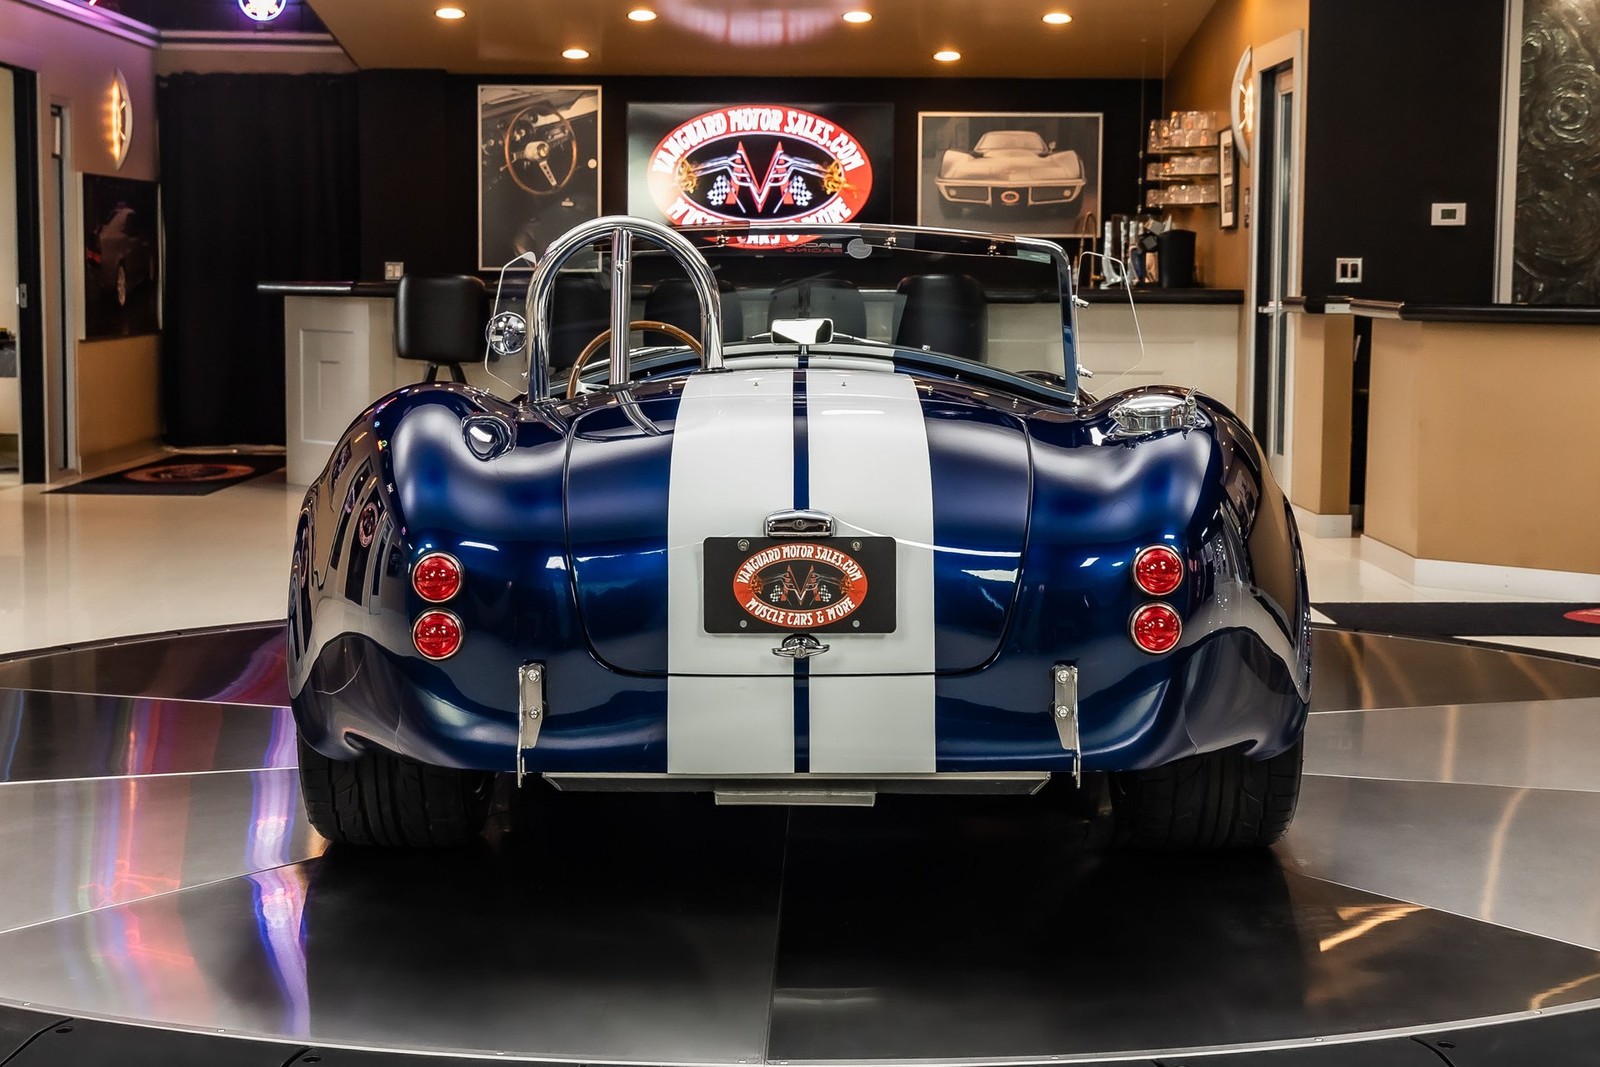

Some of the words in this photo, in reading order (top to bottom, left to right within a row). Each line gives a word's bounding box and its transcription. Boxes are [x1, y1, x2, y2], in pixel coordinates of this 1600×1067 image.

[652, 112, 727, 174] VANGUARD
[727, 107, 783, 133] MOTOR
[783, 110, 865, 172] SALES.COM
[736, 547, 781, 584] VANGUARD
[781, 545, 814, 559] MOTOR
[814, 546, 863, 582] SALES.COM
[745, 597, 786, 624] MUSCLE
[787, 612, 813, 626] CARS
[815, 610, 825, 624] &
[826, 596, 856, 621] MORE
